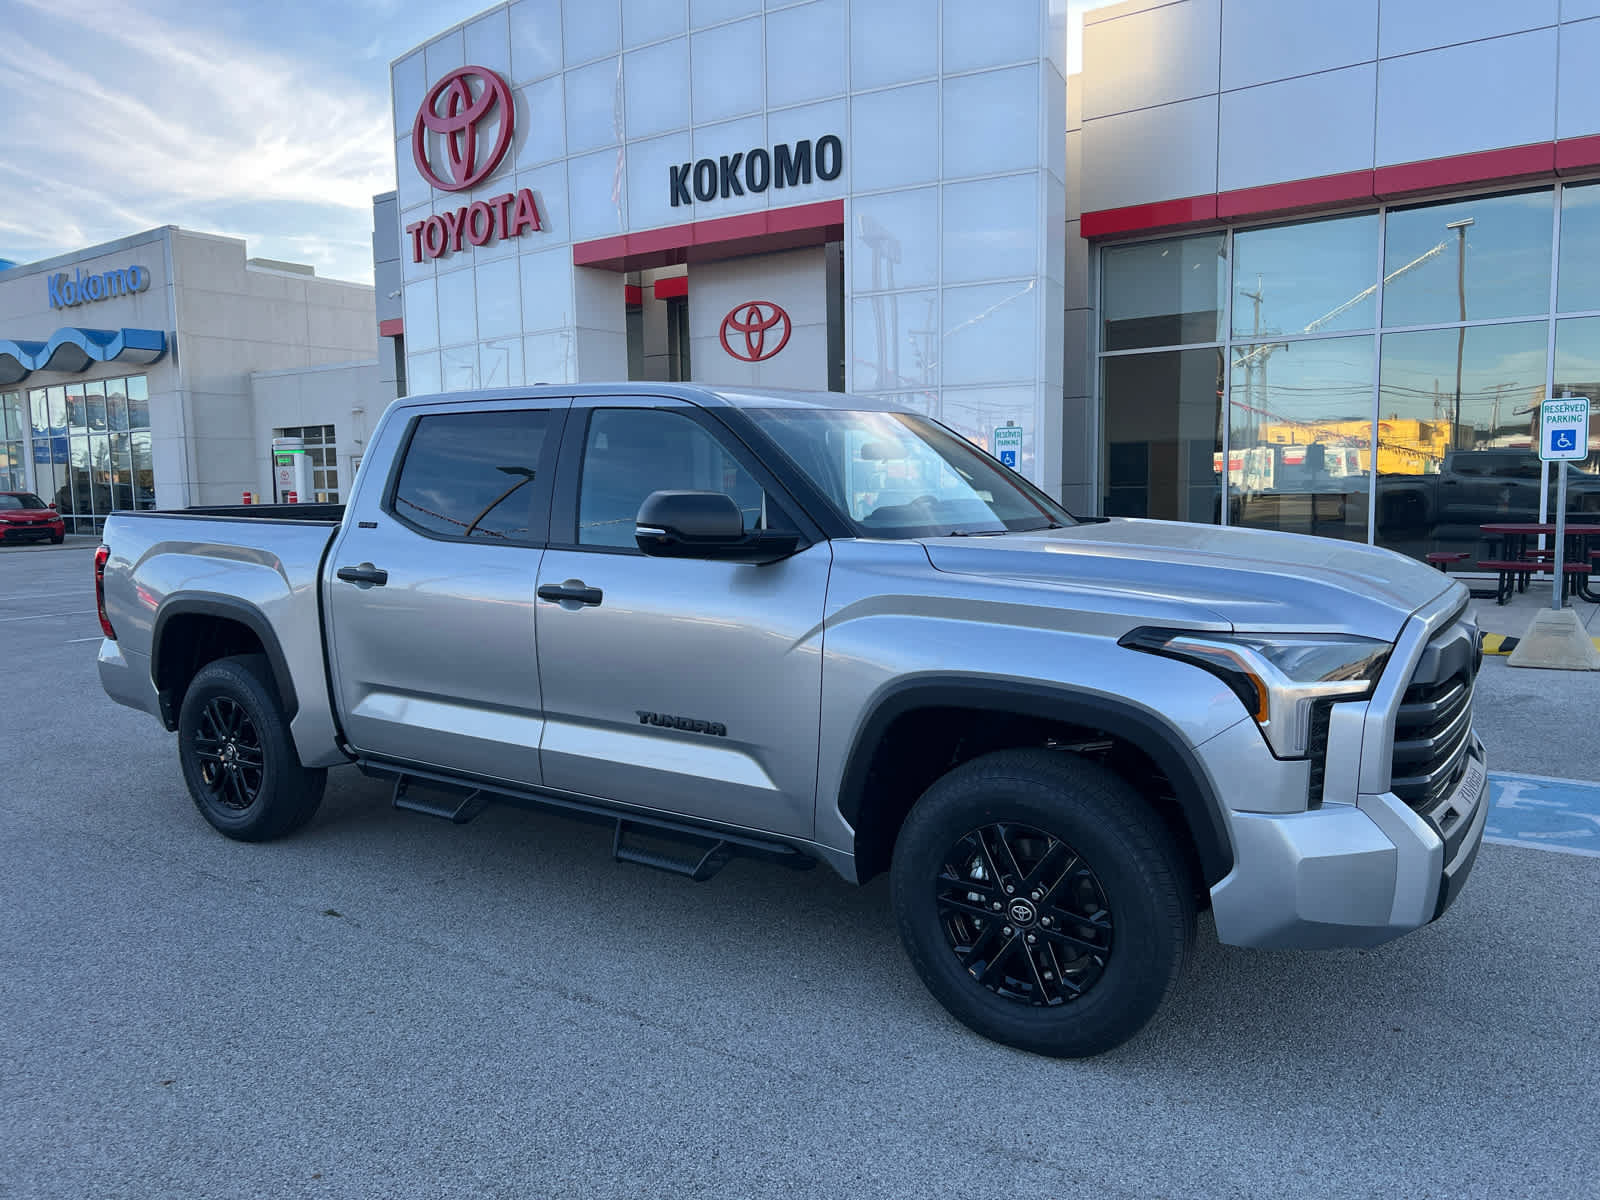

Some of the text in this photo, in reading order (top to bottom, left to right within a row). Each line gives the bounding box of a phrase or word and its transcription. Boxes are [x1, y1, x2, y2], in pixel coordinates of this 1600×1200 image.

[669, 134, 842, 207] KOKOMO
[406, 188, 541, 263] TOYOTA
[48, 265, 144, 308] Kokomo
[1544, 404, 1586, 413] RESERVED
[1546, 415, 1583, 423] PARKING
[635, 710, 727, 737] TUNDRA
